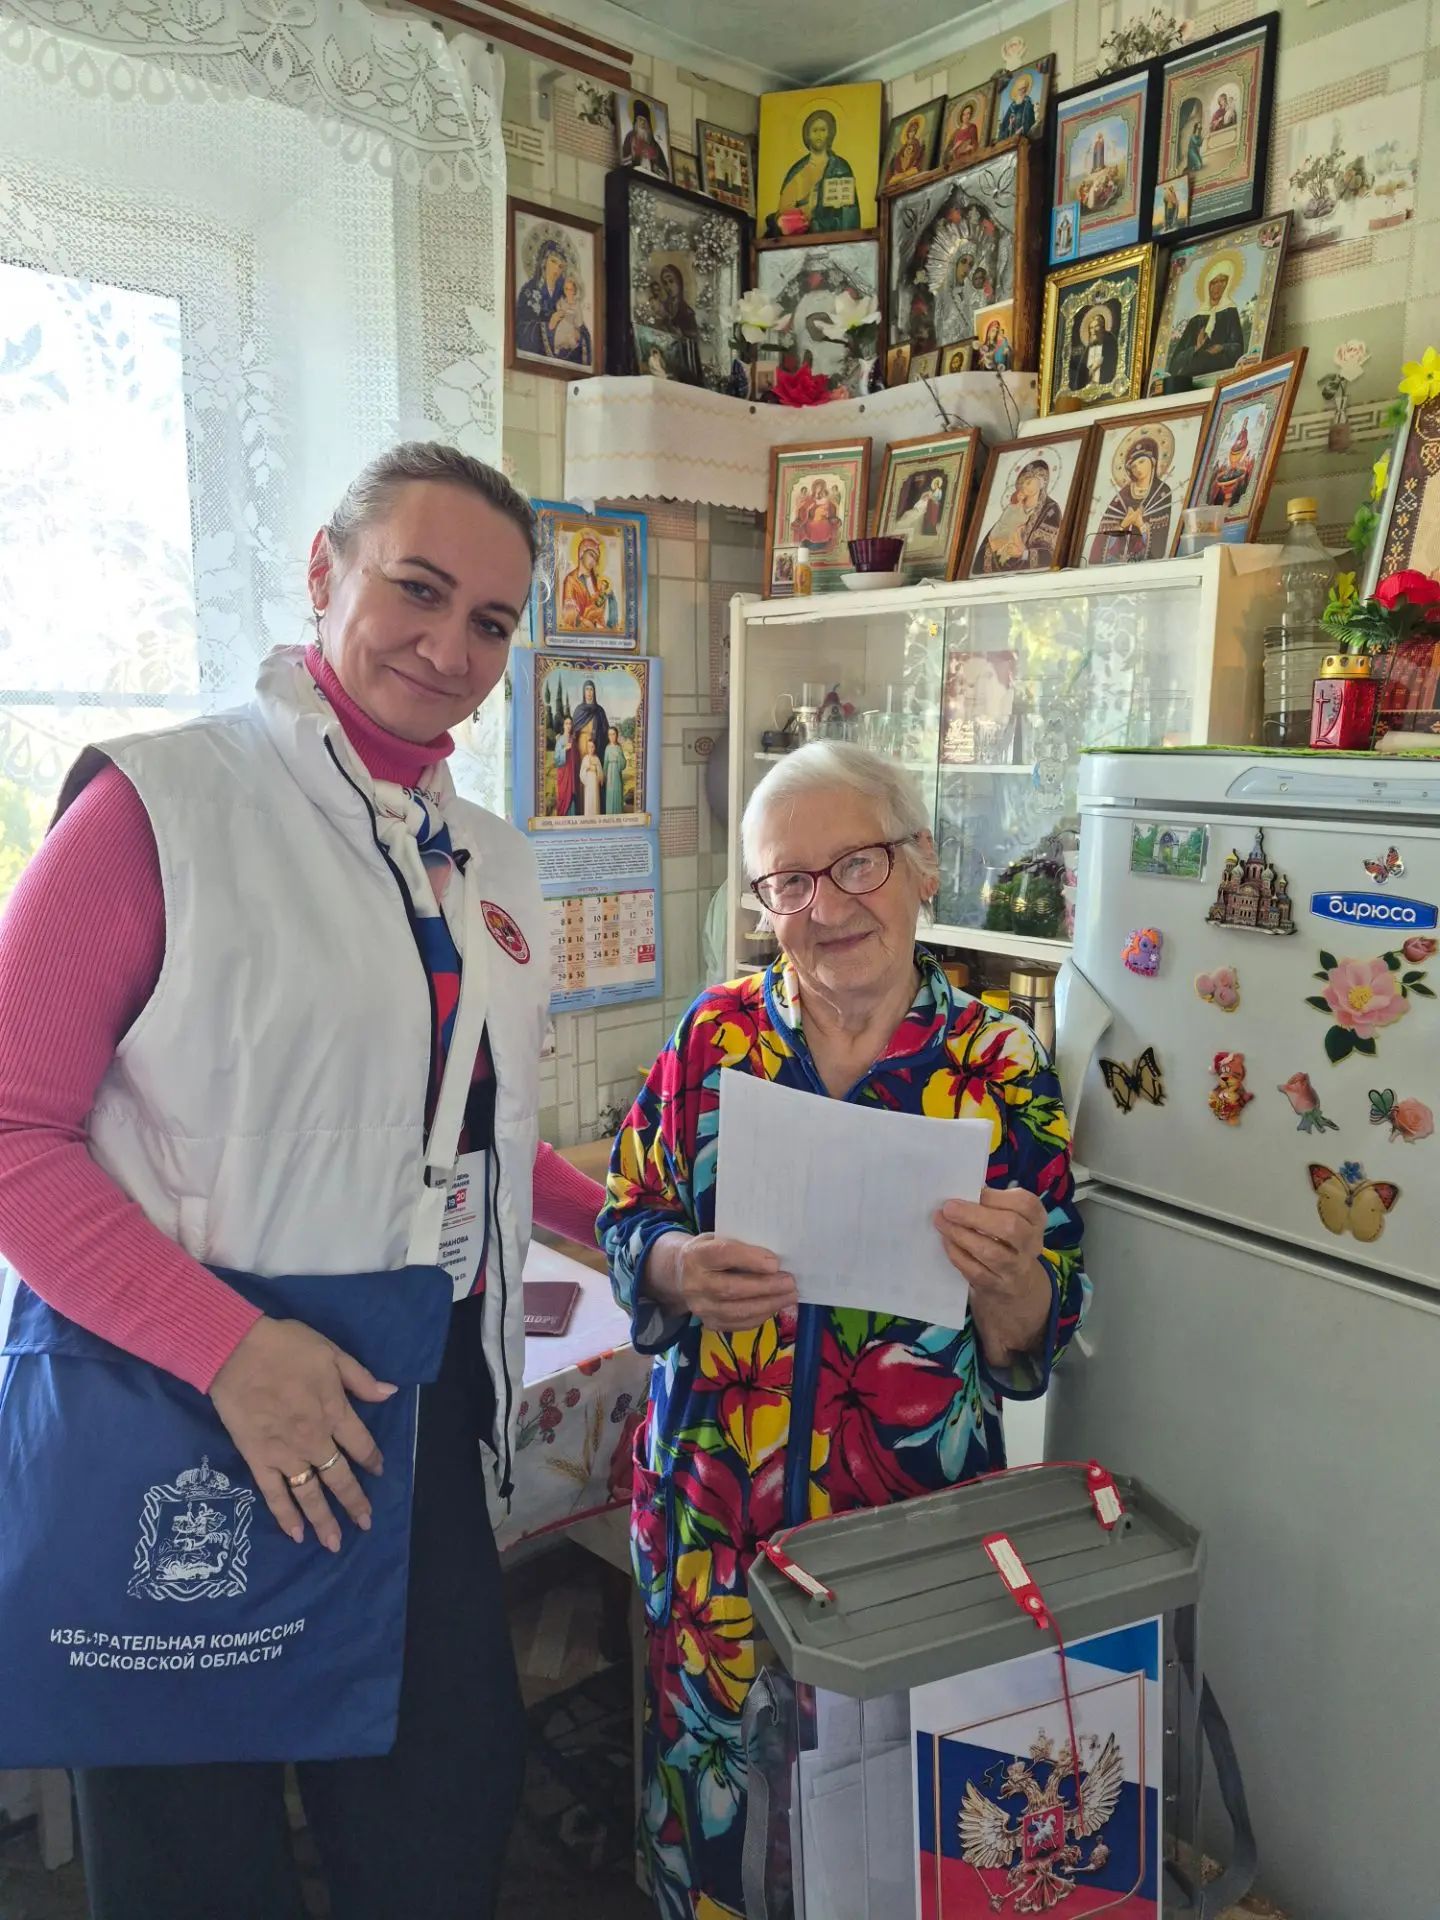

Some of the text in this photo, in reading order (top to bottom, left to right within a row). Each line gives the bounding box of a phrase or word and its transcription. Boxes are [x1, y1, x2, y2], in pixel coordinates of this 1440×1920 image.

[1329, 896, 1416, 922] бирюса
[593, 951, 602, 959] 24
[456, 1192, 465, 1201] 20
[439, 1235, 469, 1250] ОМАНОВА
[210, 1618, 306, 1649] КОМИССИЯ
[69, 1644, 283, 1671] МОСКОВСКОЙ ОБЛАСТИ
